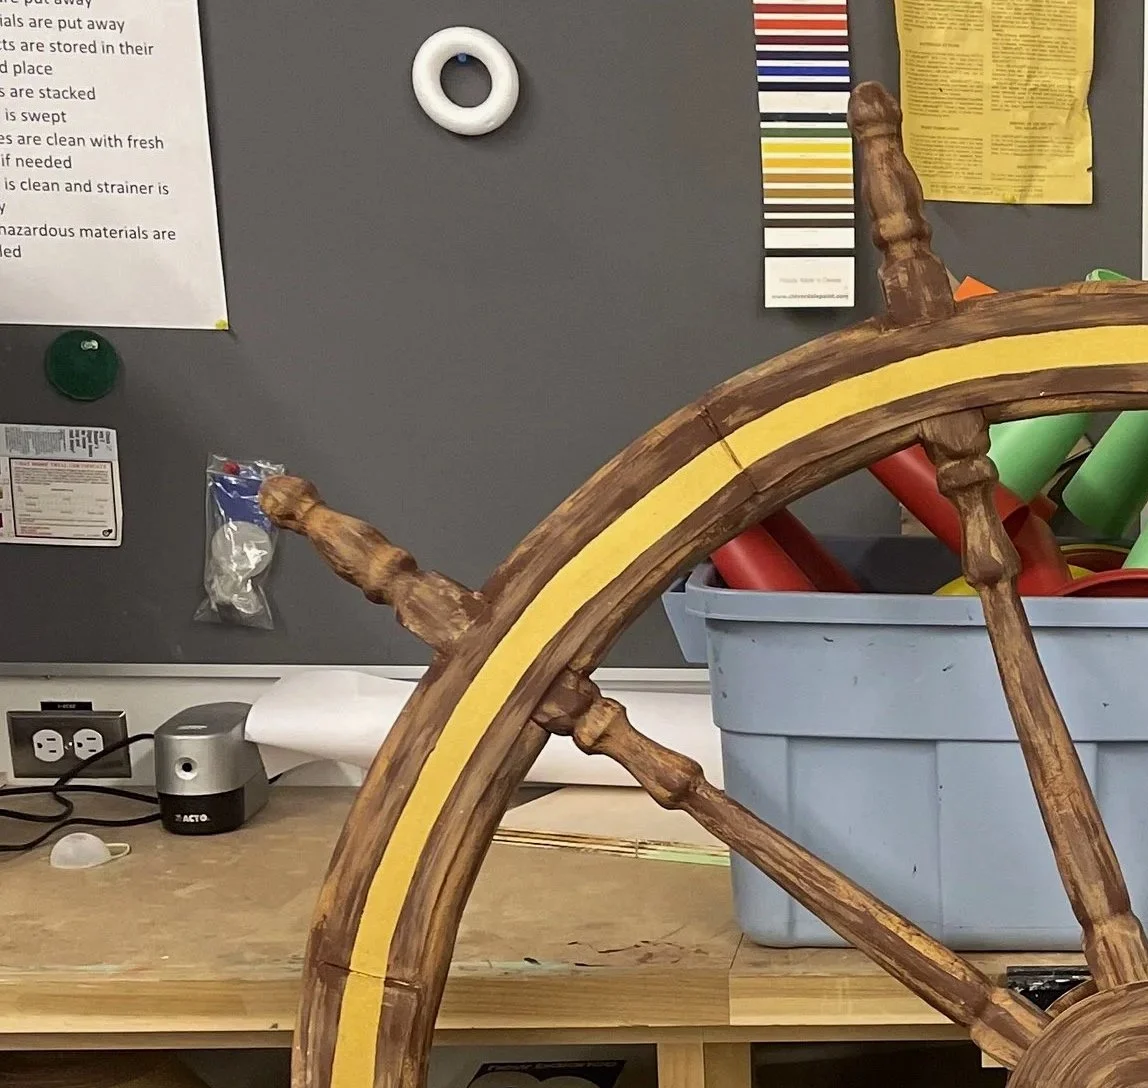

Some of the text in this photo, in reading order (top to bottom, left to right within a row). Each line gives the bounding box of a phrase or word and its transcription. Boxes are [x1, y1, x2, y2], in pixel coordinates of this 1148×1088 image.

[28, 17, 53, 29] are
[58, 17, 83, 32] put
[87, 19, 125, 34] away
[0, 39, 154, 55] ts are stored in their
[13, 60, 53, 77] place
[10, 87, 34, 99] are
[39, 85, 96, 101] stacked
[4, 107, 67, 126] is swept
[17, 134, 42, 146] are
[46, 132, 86, 147] clean
[89, 134, 123, 149] with
[127, 134, 164, 149] fresh
[1, 153, 72, 169] if needed
[4, 177, 170, 196] is clean and strainer is
[79, 225, 149, 240] materials
[152, 229, 176, 241] are
